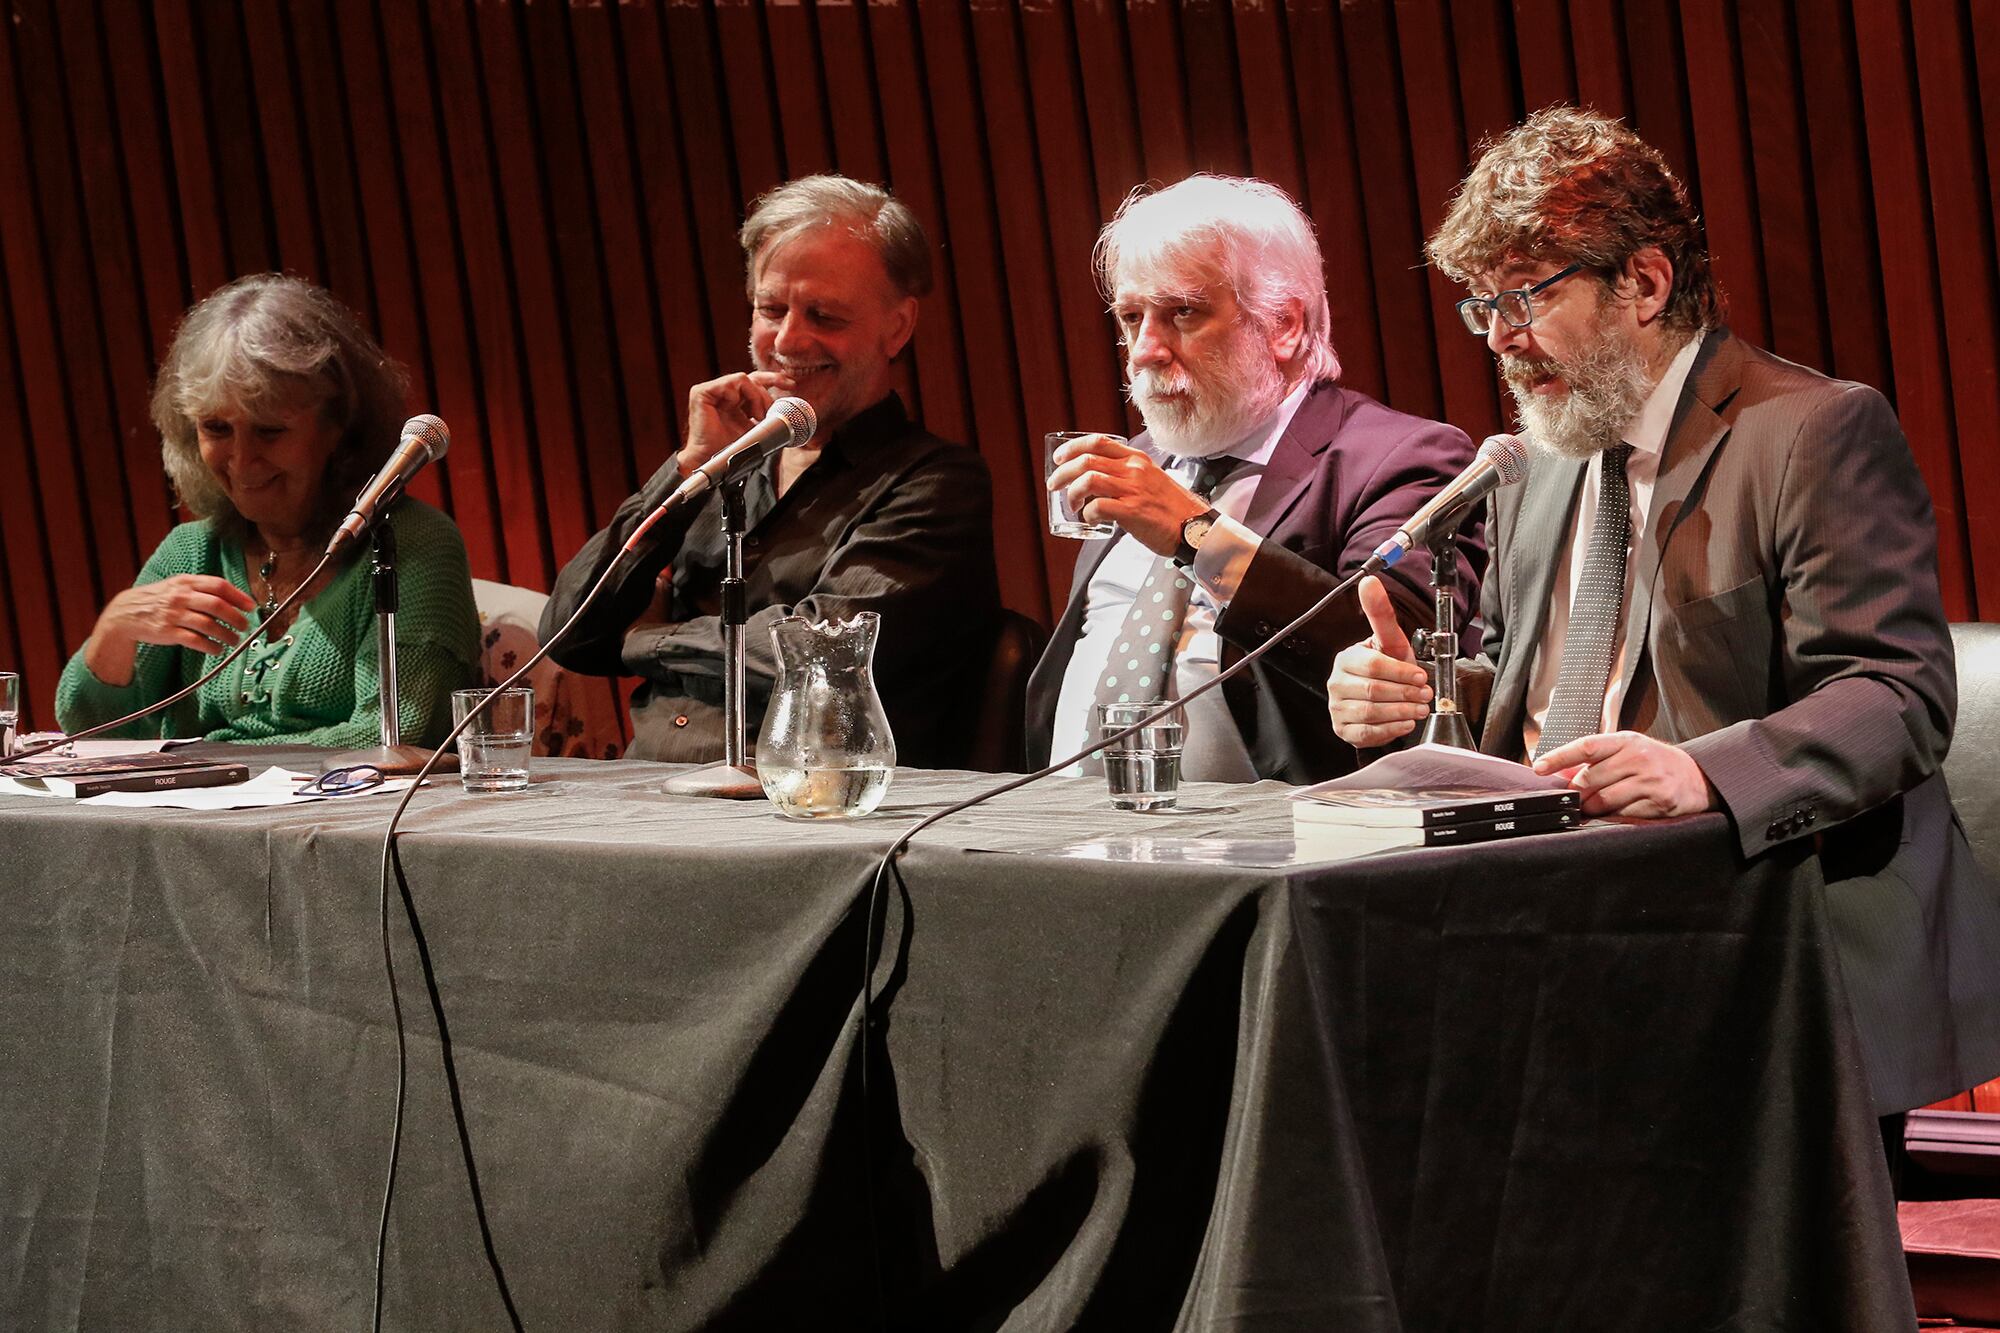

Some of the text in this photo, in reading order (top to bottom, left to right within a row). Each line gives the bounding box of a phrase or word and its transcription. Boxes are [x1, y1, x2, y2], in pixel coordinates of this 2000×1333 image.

[154, 777, 176, 785] ROUGE
[1494, 803, 1514, 812] ROUGE
[1495, 822, 1515, 831] ROUGE
